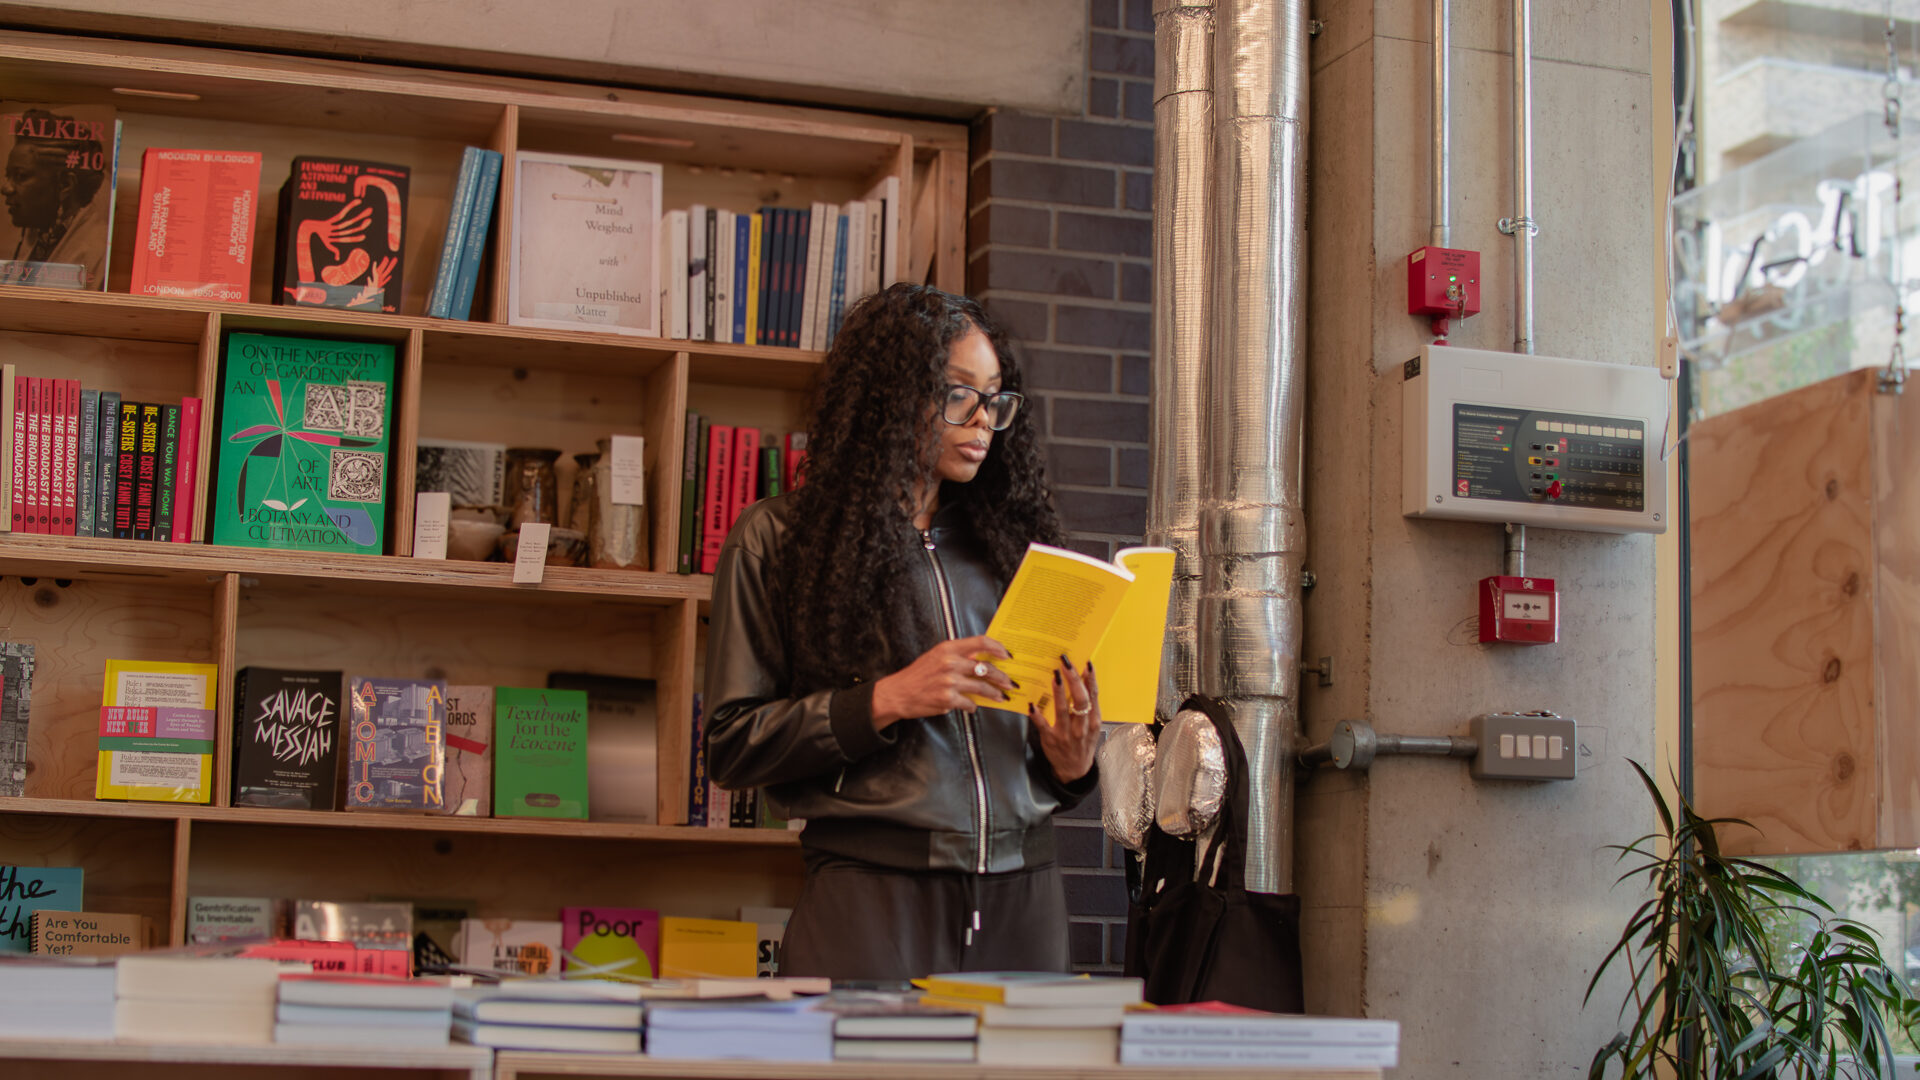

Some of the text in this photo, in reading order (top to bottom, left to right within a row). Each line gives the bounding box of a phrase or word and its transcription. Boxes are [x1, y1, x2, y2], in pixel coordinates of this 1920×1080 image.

[4, 114, 107, 141] TALKER
[65, 151, 104, 171] #10
[158, 151, 254, 164] MODERN BUILDINGS
[595, 205, 623, 216] Mind
[148, 192, 162, 251] SUTHERLAND
[156, 187, 172, 257] ANA FRANCISCO
[228, 196, 242, 256] BLACKHEATH
[236, 190, 252, 264] AND GREENWICH
[585, 220, 633, 235] Weighted
[599, 256, 619, 267] with
[143, 285, 185, 296] LONDON
[576, 287, 641, 304] Unpublished
[575, 305, 607, 317] Matter
[243, 344, 381, 368] ON THE NECESSITY
[250, 361, 370, 383] OF GARDENING
[232, 380, 256, 394] AN
[16, 411, 24, 429] THE
[29, 413, 38, 431] THE
[42, 414, 51, 431] THE
[55, 415, 64, 431] THE
[68, 415, 77, 432] THE
[167, 408, 177, 438] DANCE
[84, 414, 94, 455] OTHERWISE
[105, 416, 115, 457] OTHERWISE
[14, 430, 24, 491] BROADCAST
[165, 440, 174, 464] YOUR
[28, 432, 38, 493] BROADCAST
[40, 432, 50, 494] BROADCAST
[53, 432, 63, 494] BROADCAST
[66, 433, 76, 495] BROADCAST
[119, 454, 133, 479] COSEY
[140, 456, 154, 480] COSEY
[298, 459, 320, 474] OF
[163, 468, 172, 487] WAY
[14, 493, 23, 504] 41
[27, 494, 36, 506] 41
[40, 494, 49, 507] 41
[52, 495, 62, 507] 41
[65, 496, 74, 508] 41
[117, 482, 132, 505] FANNI
[138, 483, 152, 506] FANNI
[161, 489, 170, 516] HOME
[116, 506, 130, 528] TUTTI
[136, 507, 151, 530] TUTTI
[248, 508, 351, 529] BOTANY AND
[248, 525, 349, 544] CULTIVATION
[253, 688, 335, 728] SAVAGE
[536, 694, 549, 707] A
[108, 709, 149, 721] NEW RULES
[505, 706, 581, 724] Textbook
[106, 721, 126, 733] NEXT
[516, 721, 570, 737] for the
[255, 721, 331, 767] MESSIAH
[509, 735, 576, 752] Ecocene
[195, 903, 261, 914] Gentrification
[45, 917, 98, 930] Are You
[196, 914, 254, 924] Is Inevitable
[579, 910, 642, 938] Poor
[45, 931, 130, 945] Comfortable
[45, 944, 73, 956] Yet?
[494, 945, 550, 961] A NATURAL
[312, 959, 346, 971] CLUB
